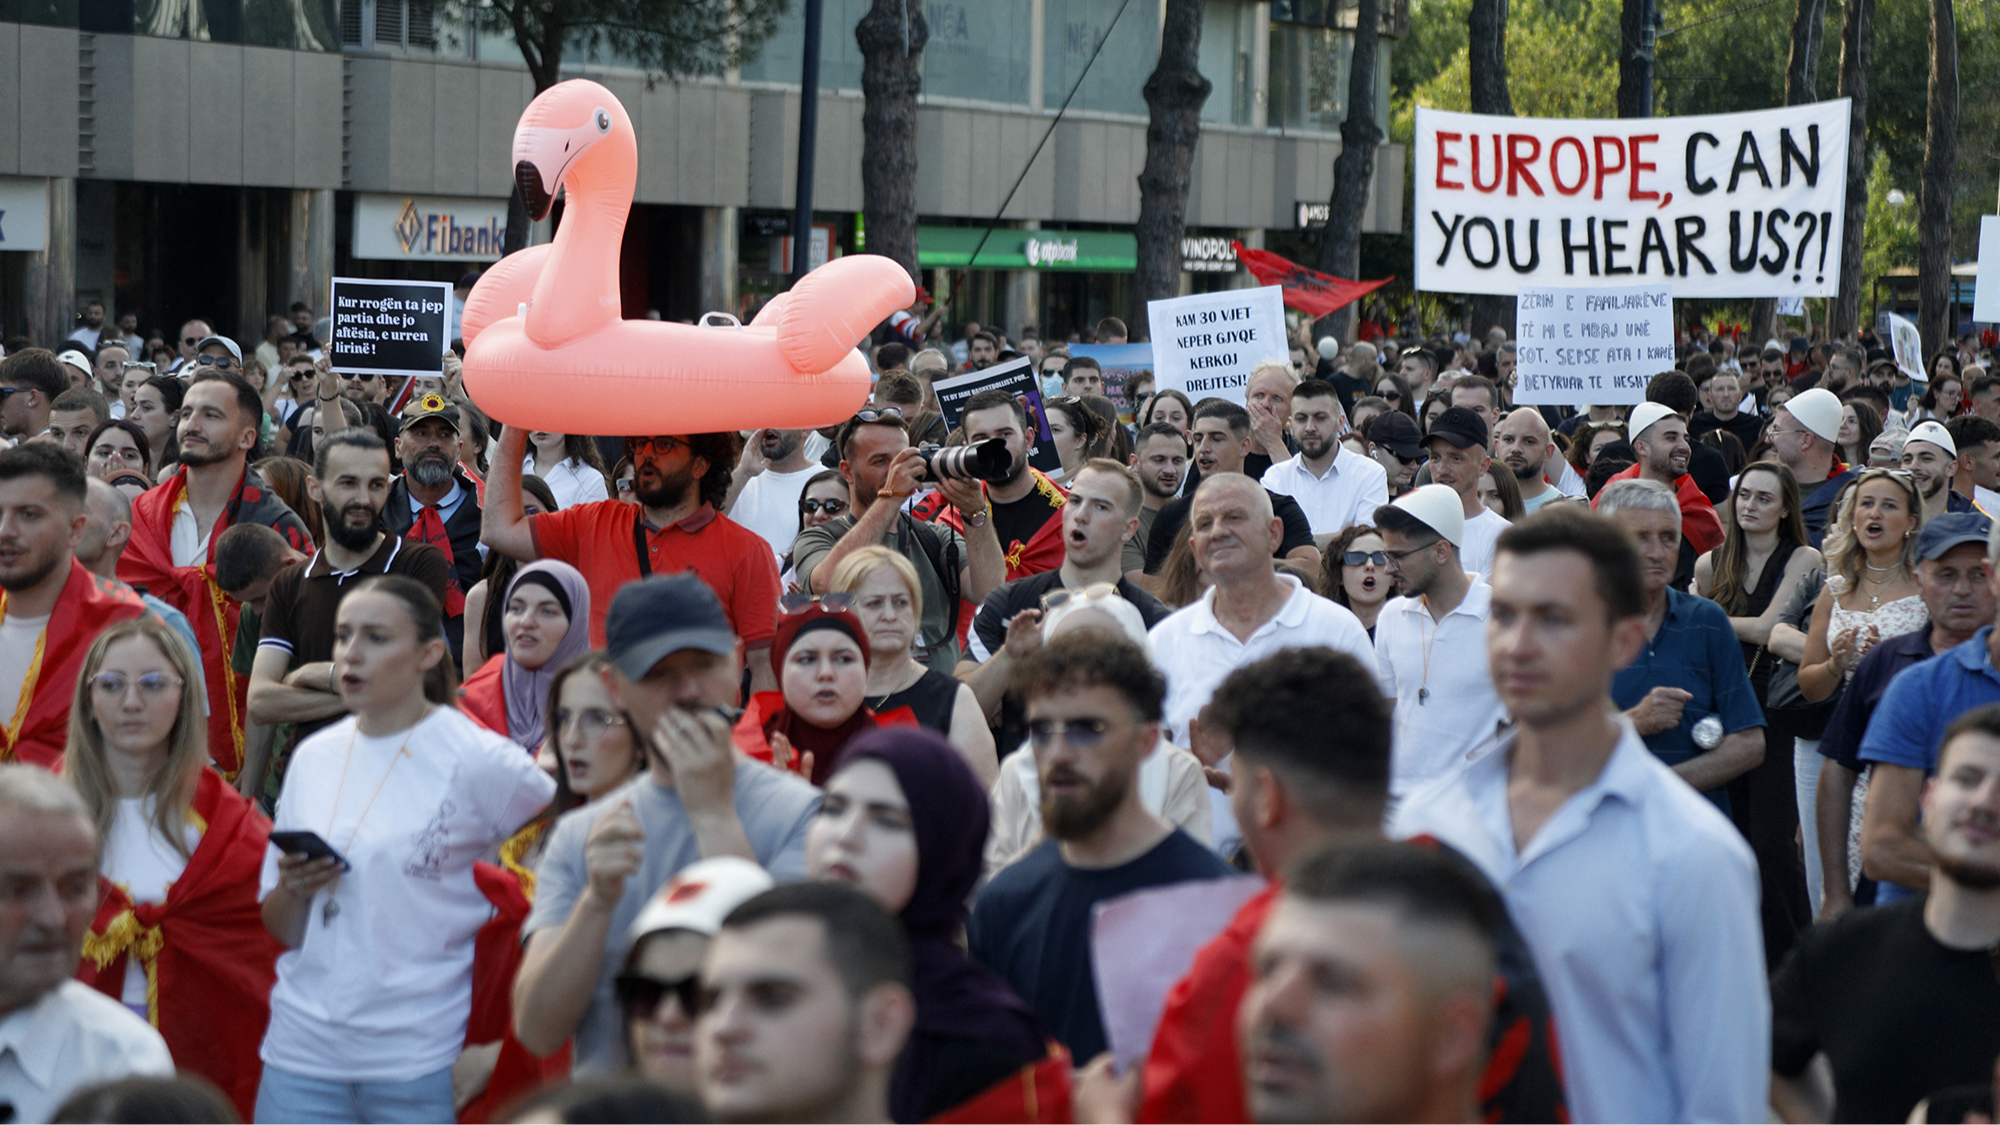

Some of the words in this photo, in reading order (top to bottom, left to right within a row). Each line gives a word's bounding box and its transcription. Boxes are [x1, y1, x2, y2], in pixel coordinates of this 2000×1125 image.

[1435, 130, 1674, 209] EUROPE,
[1685, 124, 1820, 196] CAN
[424, 213, 505, 255] Fibank
[1432, 210, 1540, 274] YOU
[1561, 215, 1718, 277] HEAR
[1728, 208, 1832, 284] US?!
[338, 296, 358, 309] Kur
[359, 297, 403, 312] rrogën
[405, 300, 419, 311] ta
[421, 298, 444, 314] jep
[1521, 291, 1554, 310] ZËRIN
[1566, 294, 1574, 311] E
[1586, 291, 1668, 312] FAMILJARËVE
[337, 312, 375, 325] partia
[376, 313, 401, 325] dhe
[402, 314, 416, 328] jo
[1176, 313, 1196, 328] KAM
[1199, 311, 1217, 325] 30
[1220, 306, 1252, 322] VJET
[336, 326, 380, 341] aftësia,
[381, 331, 390, 340] e
[391, 331, 429, 341] urren
[1177, 333, 1213, 349] NEPER
[1216, 328, 1258, 344] GJYQE
[1563, 323, 1573, 339] E
[1581, 322, 1619, 340] MBAJ
[1625, 319, 1651, 337] UNË
[1190, 353, 1238, 370] KERKOJ
[1519, 346, 1548, 365] SOT.
[1555, 347, 1601, 366] SEPSE
[1607, 347, 1632, 364] ATA
[1647, 344, 1674, 361] KANË
[1186, 374, 1247, 393] DREJTESI!
[1523, 374, 1584, 392] DETYRUAR
[1588, 375, 1603, 389] TE
[1613, 374, 1654, 389] HESHT
